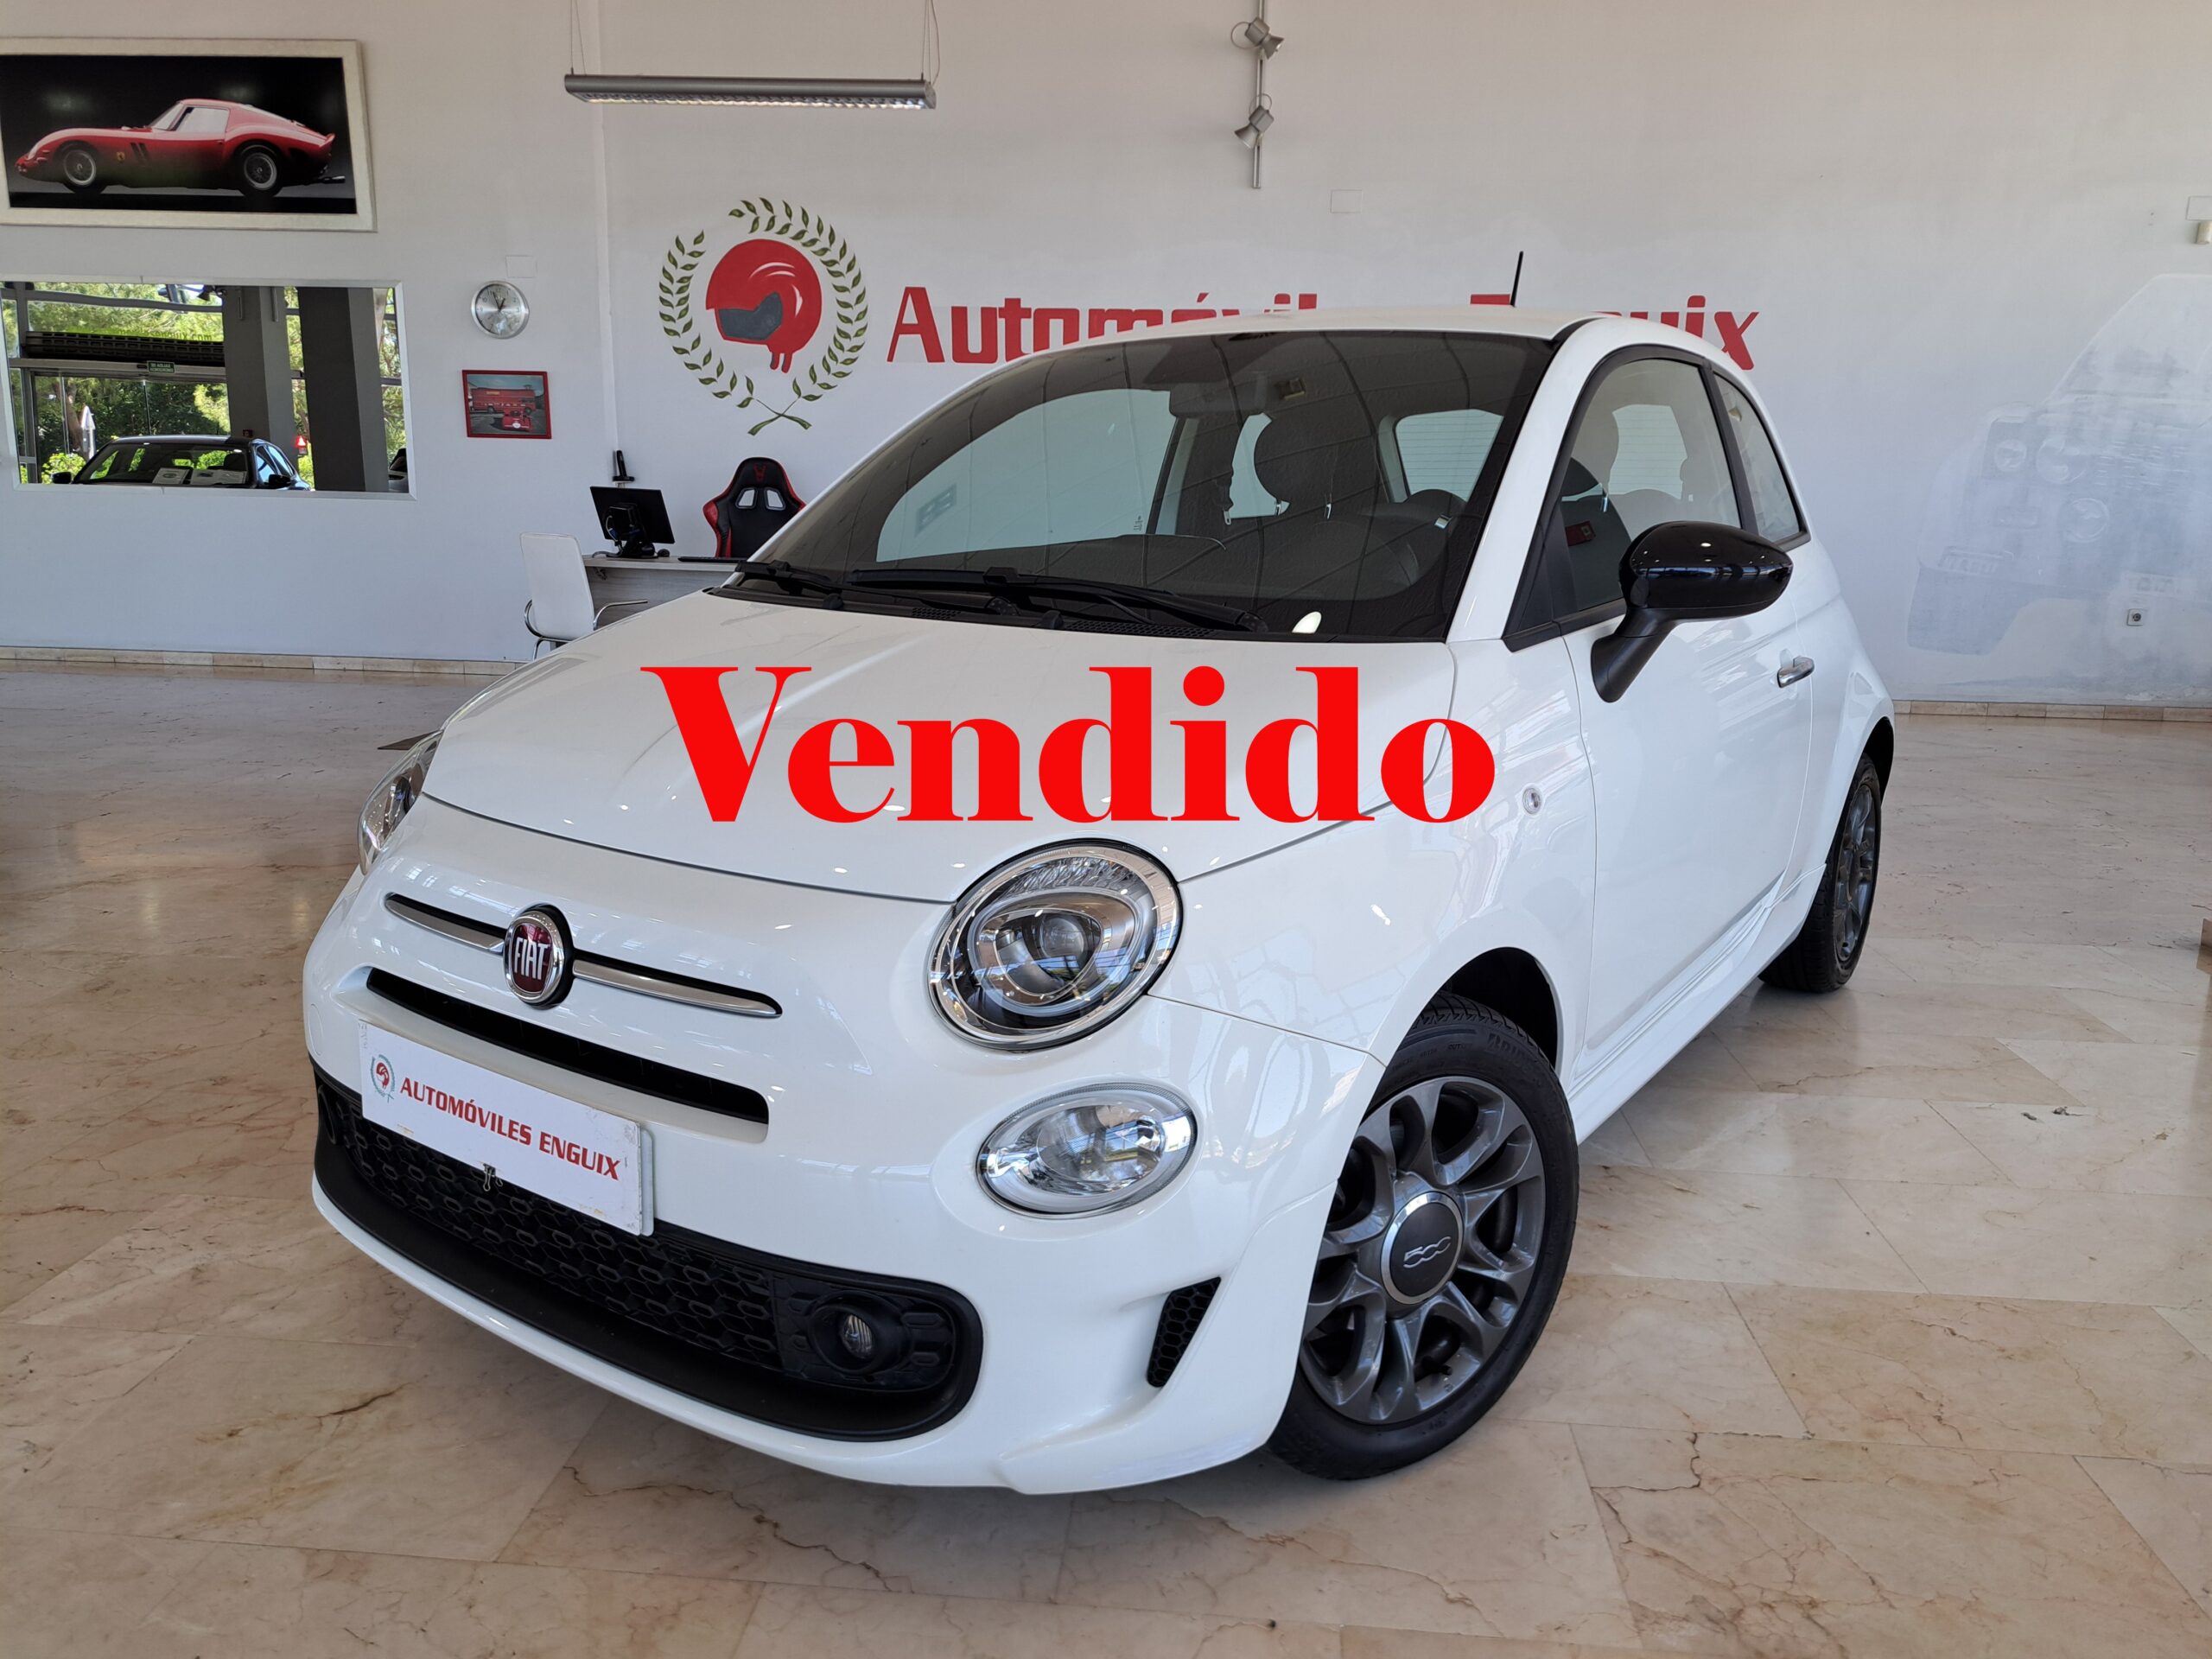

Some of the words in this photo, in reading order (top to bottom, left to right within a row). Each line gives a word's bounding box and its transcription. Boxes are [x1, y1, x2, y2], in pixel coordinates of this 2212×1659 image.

[514, 937, 549, 980] FIAT
[400, 1077, 532, 1146] AUTOMÓVILES
[539, 1131, 620, 1181] ENGUIX
[1403, 1236, 1452, 1268] 500
